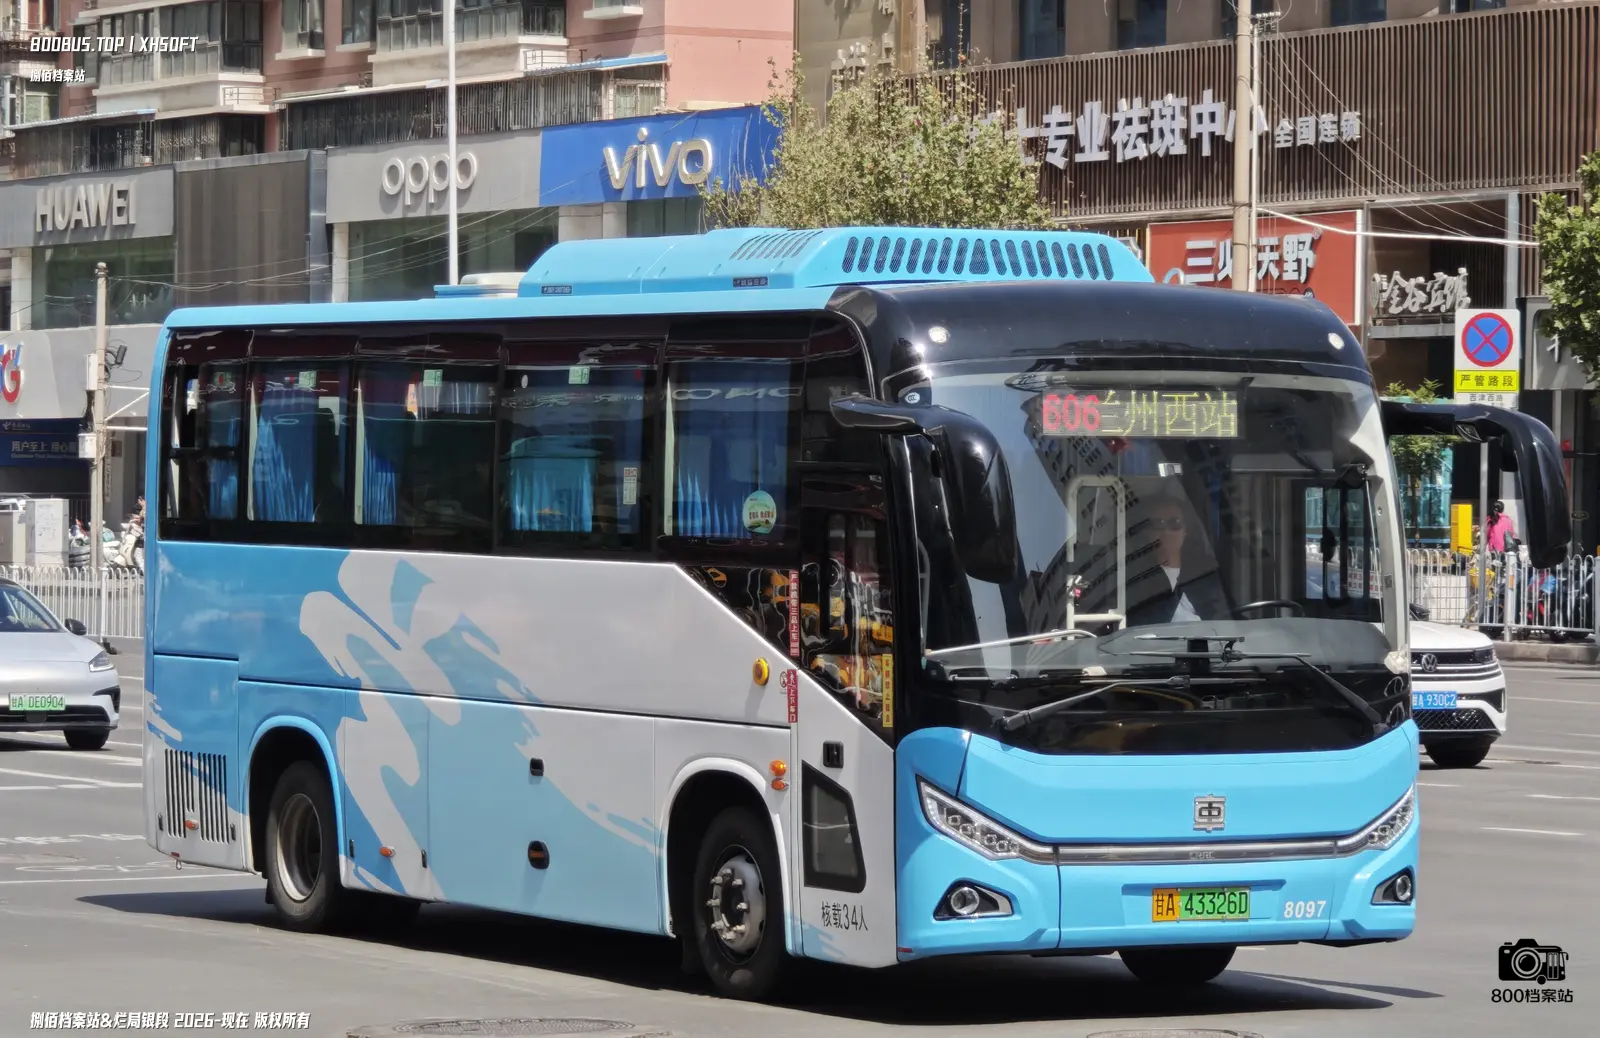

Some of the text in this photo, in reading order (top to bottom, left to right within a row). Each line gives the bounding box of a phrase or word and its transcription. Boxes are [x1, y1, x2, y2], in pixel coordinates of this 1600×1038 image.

[1275, 112, 1361, 148] 全国连锁
[603, 127, 713, 190] vivo
[36, 179, 138, 232] HUAWEI
[1460, 374, 1514, 387] 严管路段
[1042, 393, 1101, 432] 606
[821, 901, 868, 931] 核载34人
[1184, 892, 1249, 916] 43326D
[1283, 901, 1327, 918] 8097
